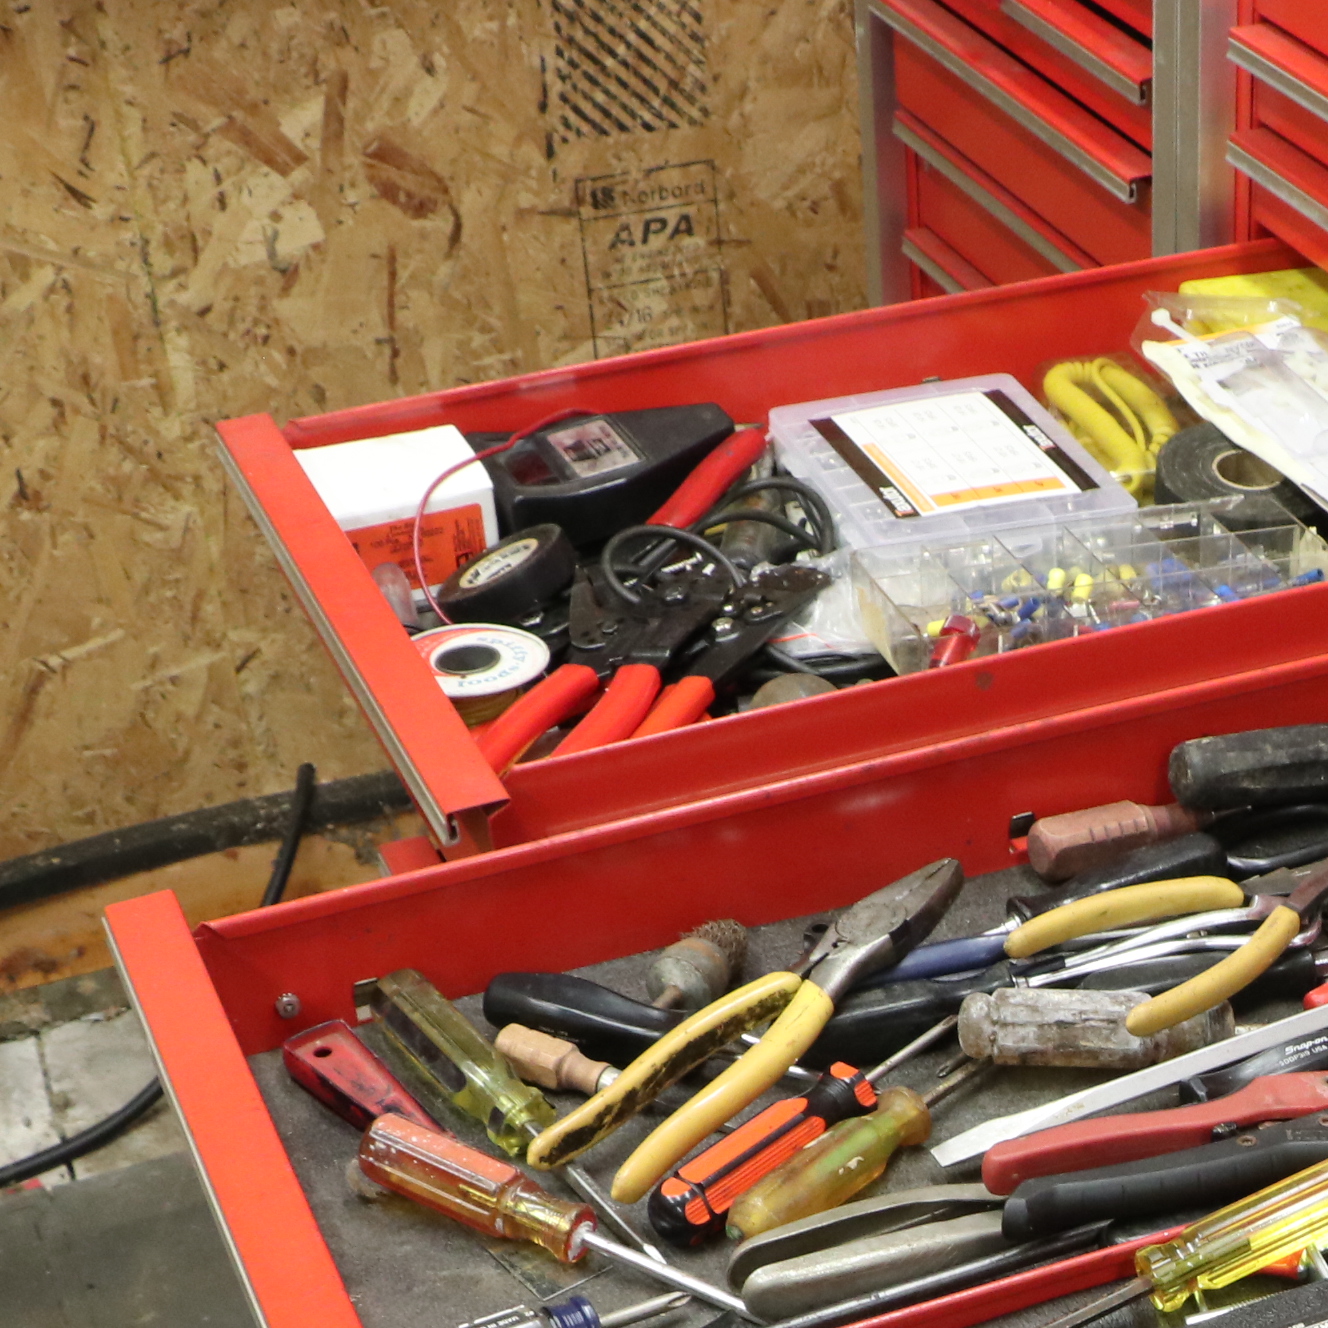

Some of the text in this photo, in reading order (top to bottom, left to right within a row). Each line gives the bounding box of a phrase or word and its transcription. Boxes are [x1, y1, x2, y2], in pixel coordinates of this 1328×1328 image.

[608, 214, 695, 250] APA
[1285, 1033, 1327, 1055] Snap-on
[1311, 1043, 1327, 1053] USA
